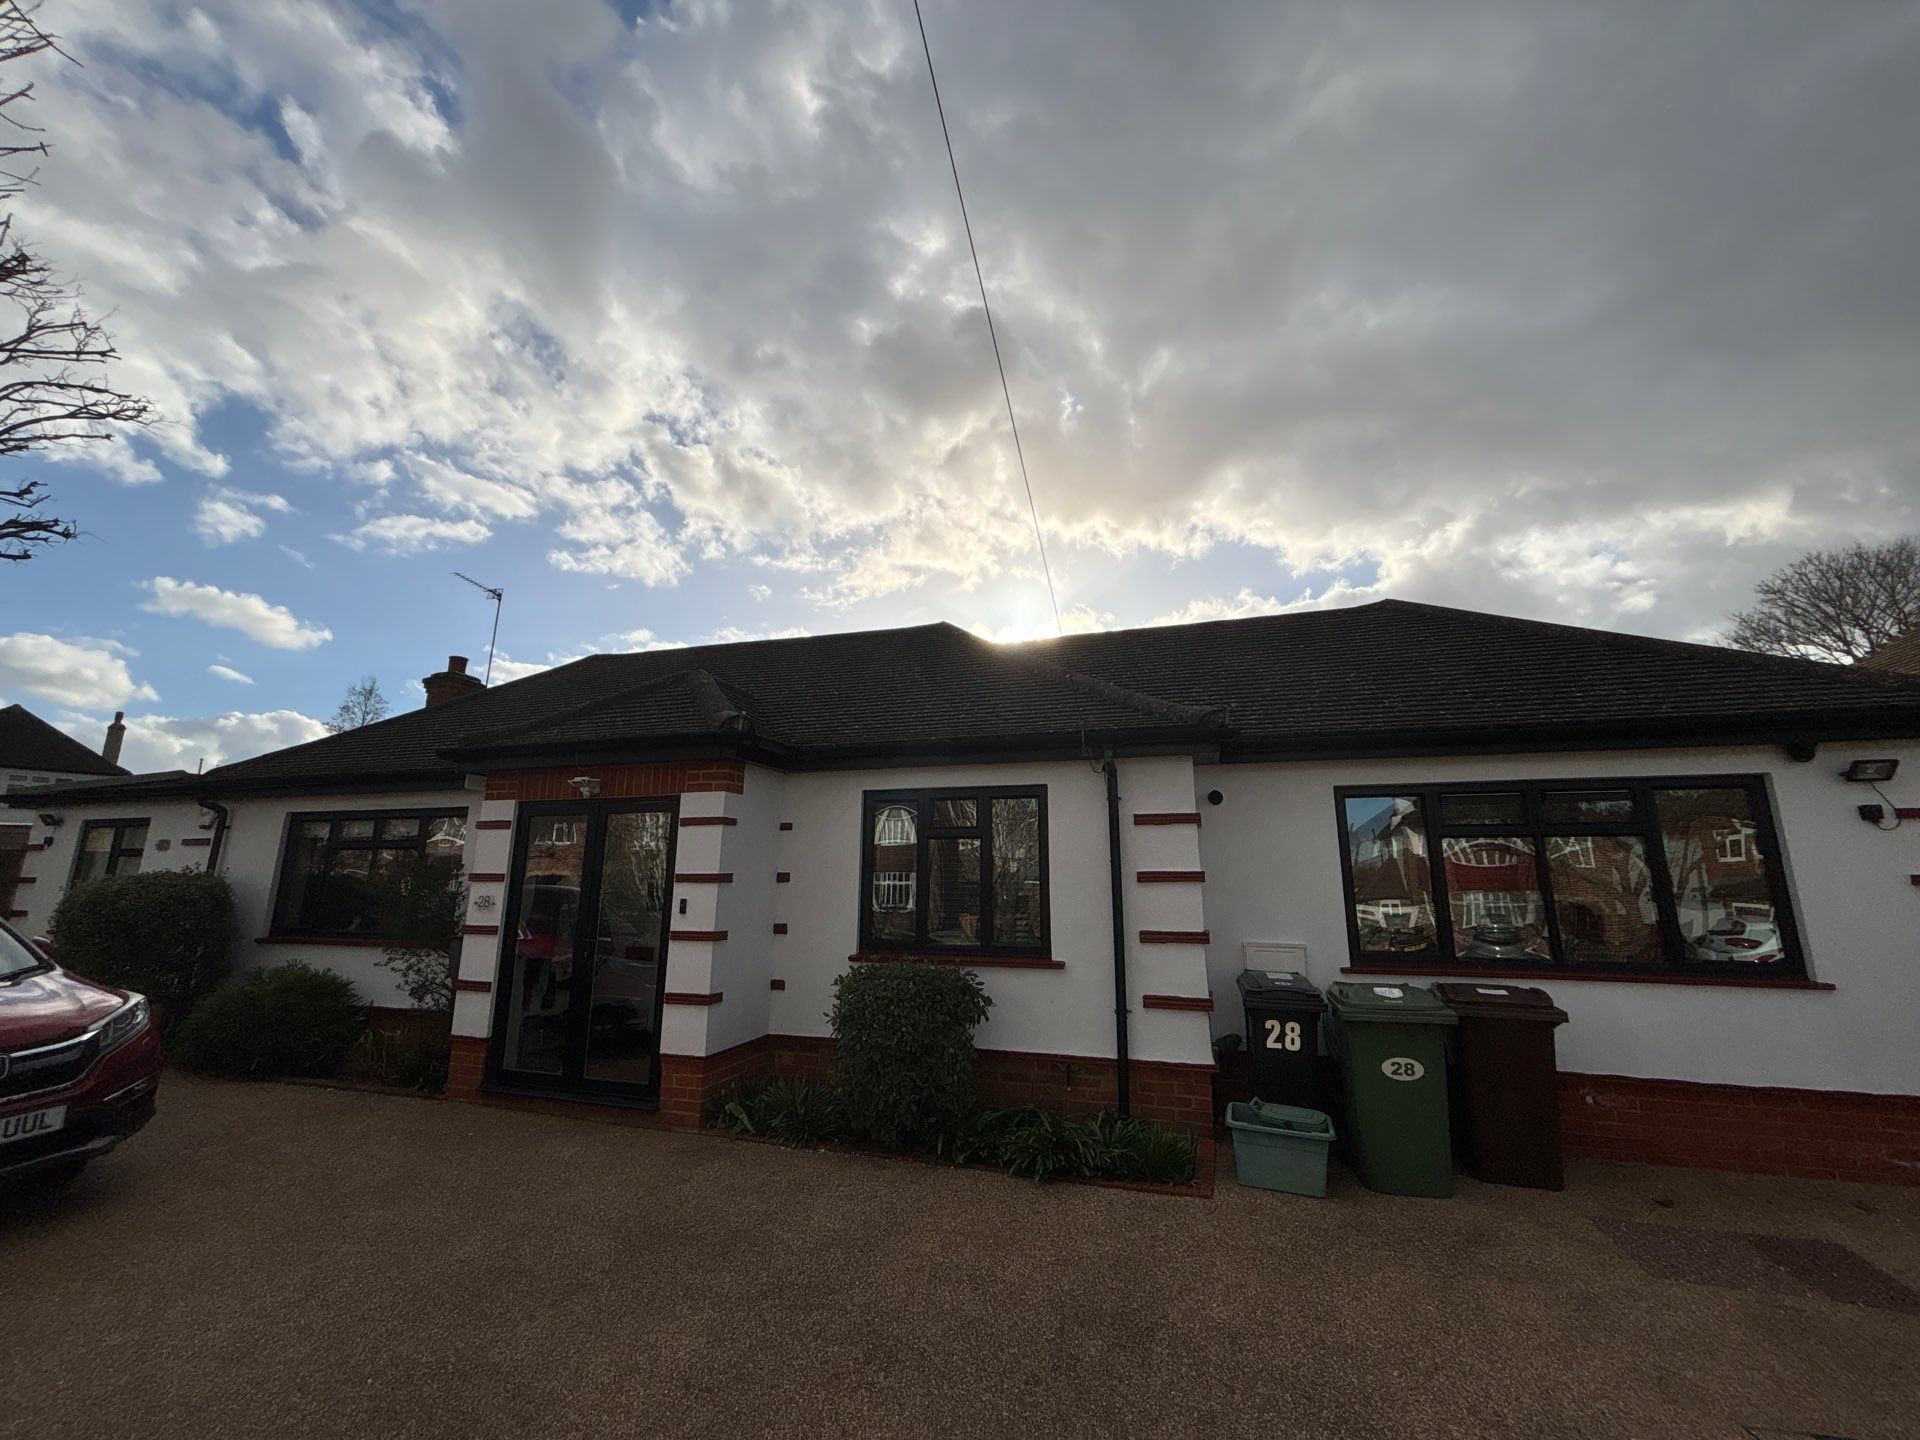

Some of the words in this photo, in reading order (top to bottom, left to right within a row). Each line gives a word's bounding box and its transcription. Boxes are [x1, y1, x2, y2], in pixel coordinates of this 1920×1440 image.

[477, 895, 491, 908] 28
[1264, 1019, 1301, 1052] 28
[1390, 1061, 1416, 1077] 28
[3, 1111, 53, 1139] UUL
